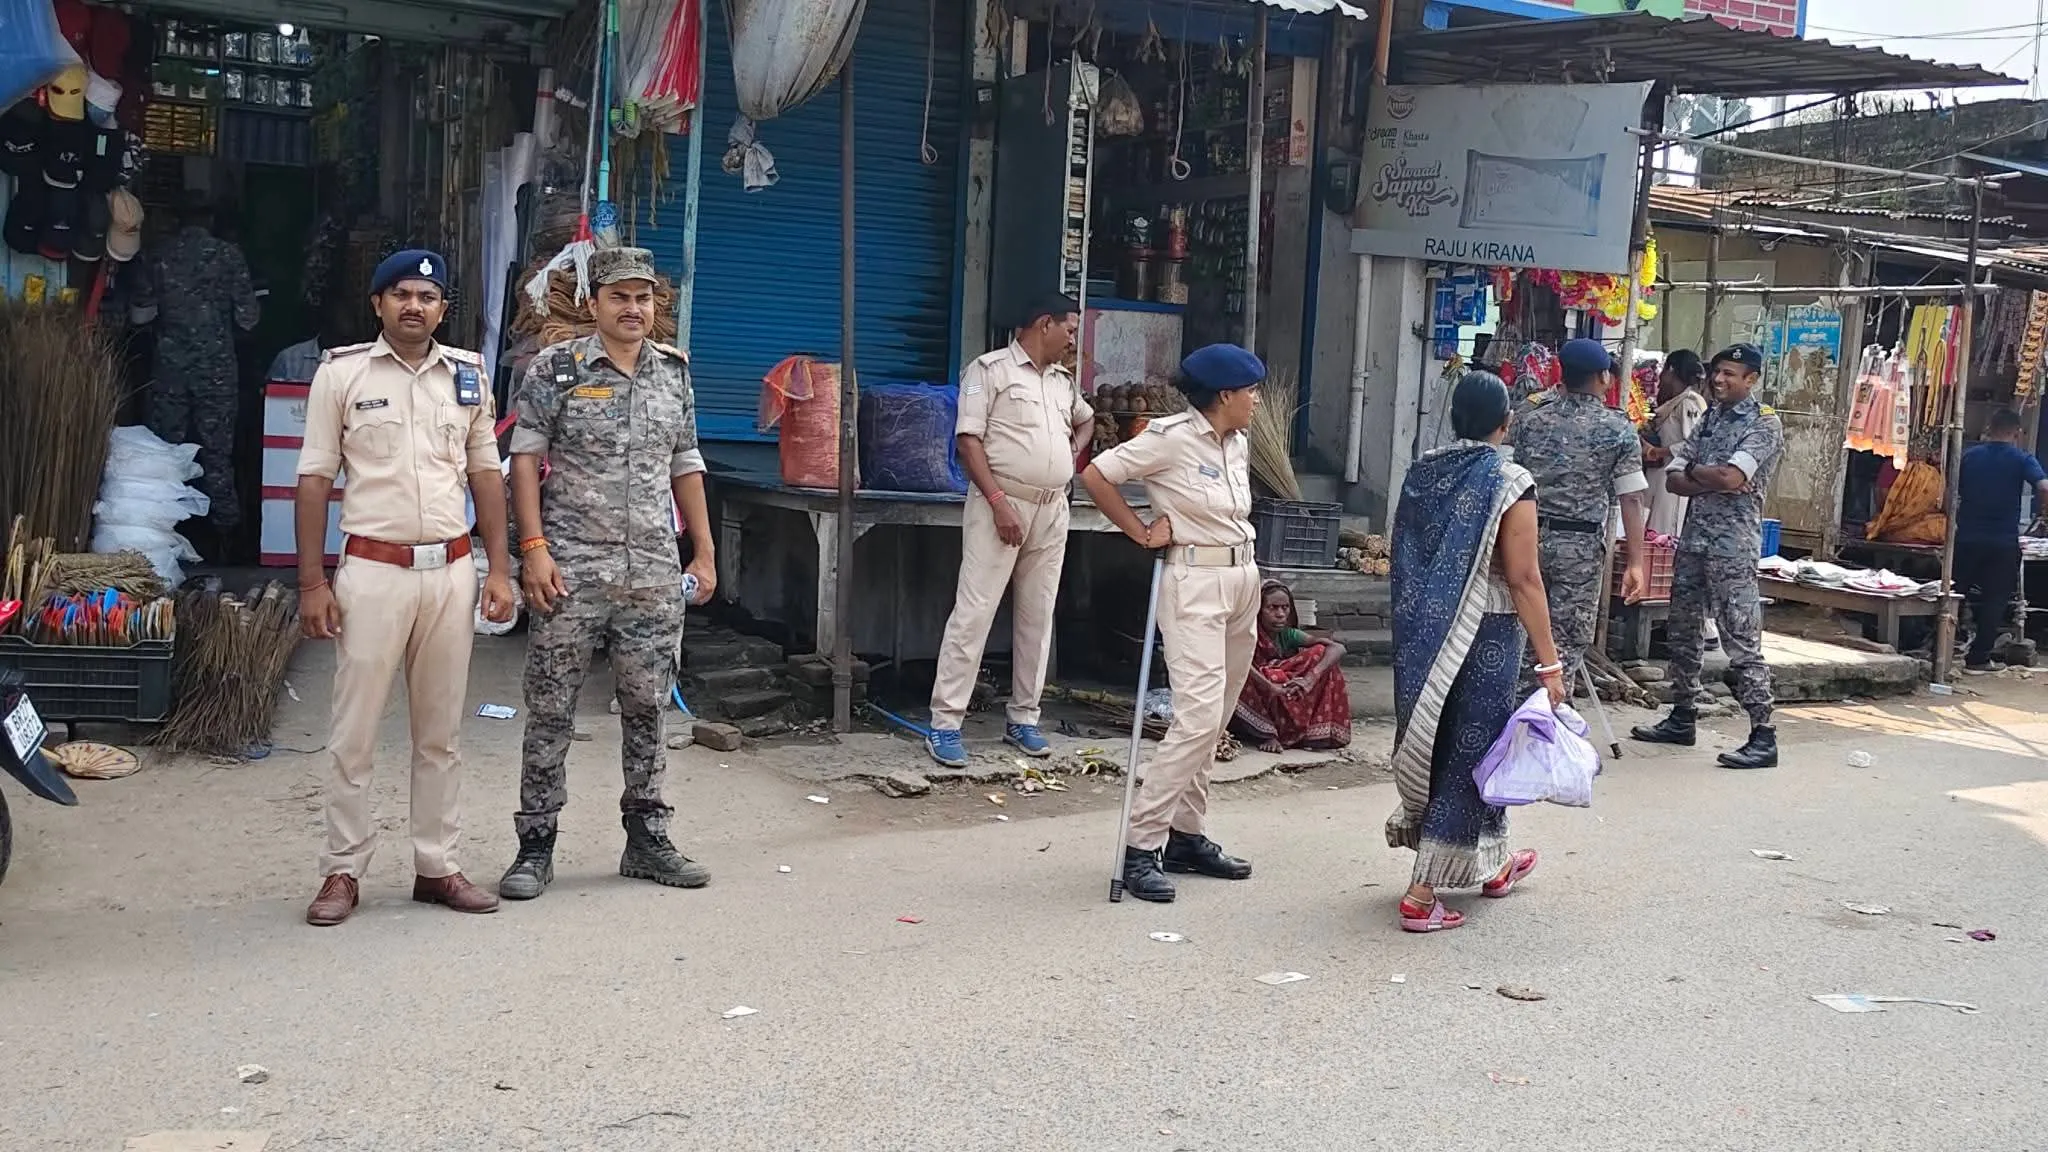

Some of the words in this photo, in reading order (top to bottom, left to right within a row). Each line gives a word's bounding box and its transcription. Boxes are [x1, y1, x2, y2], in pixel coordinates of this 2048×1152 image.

[1381, 139, 1397, 149] LITE
[1372, 163, 1436, 207] Sapno
[1424, 238, 1467, 257] RAJU
[1471, 241, 1536, 263] KIRANA
